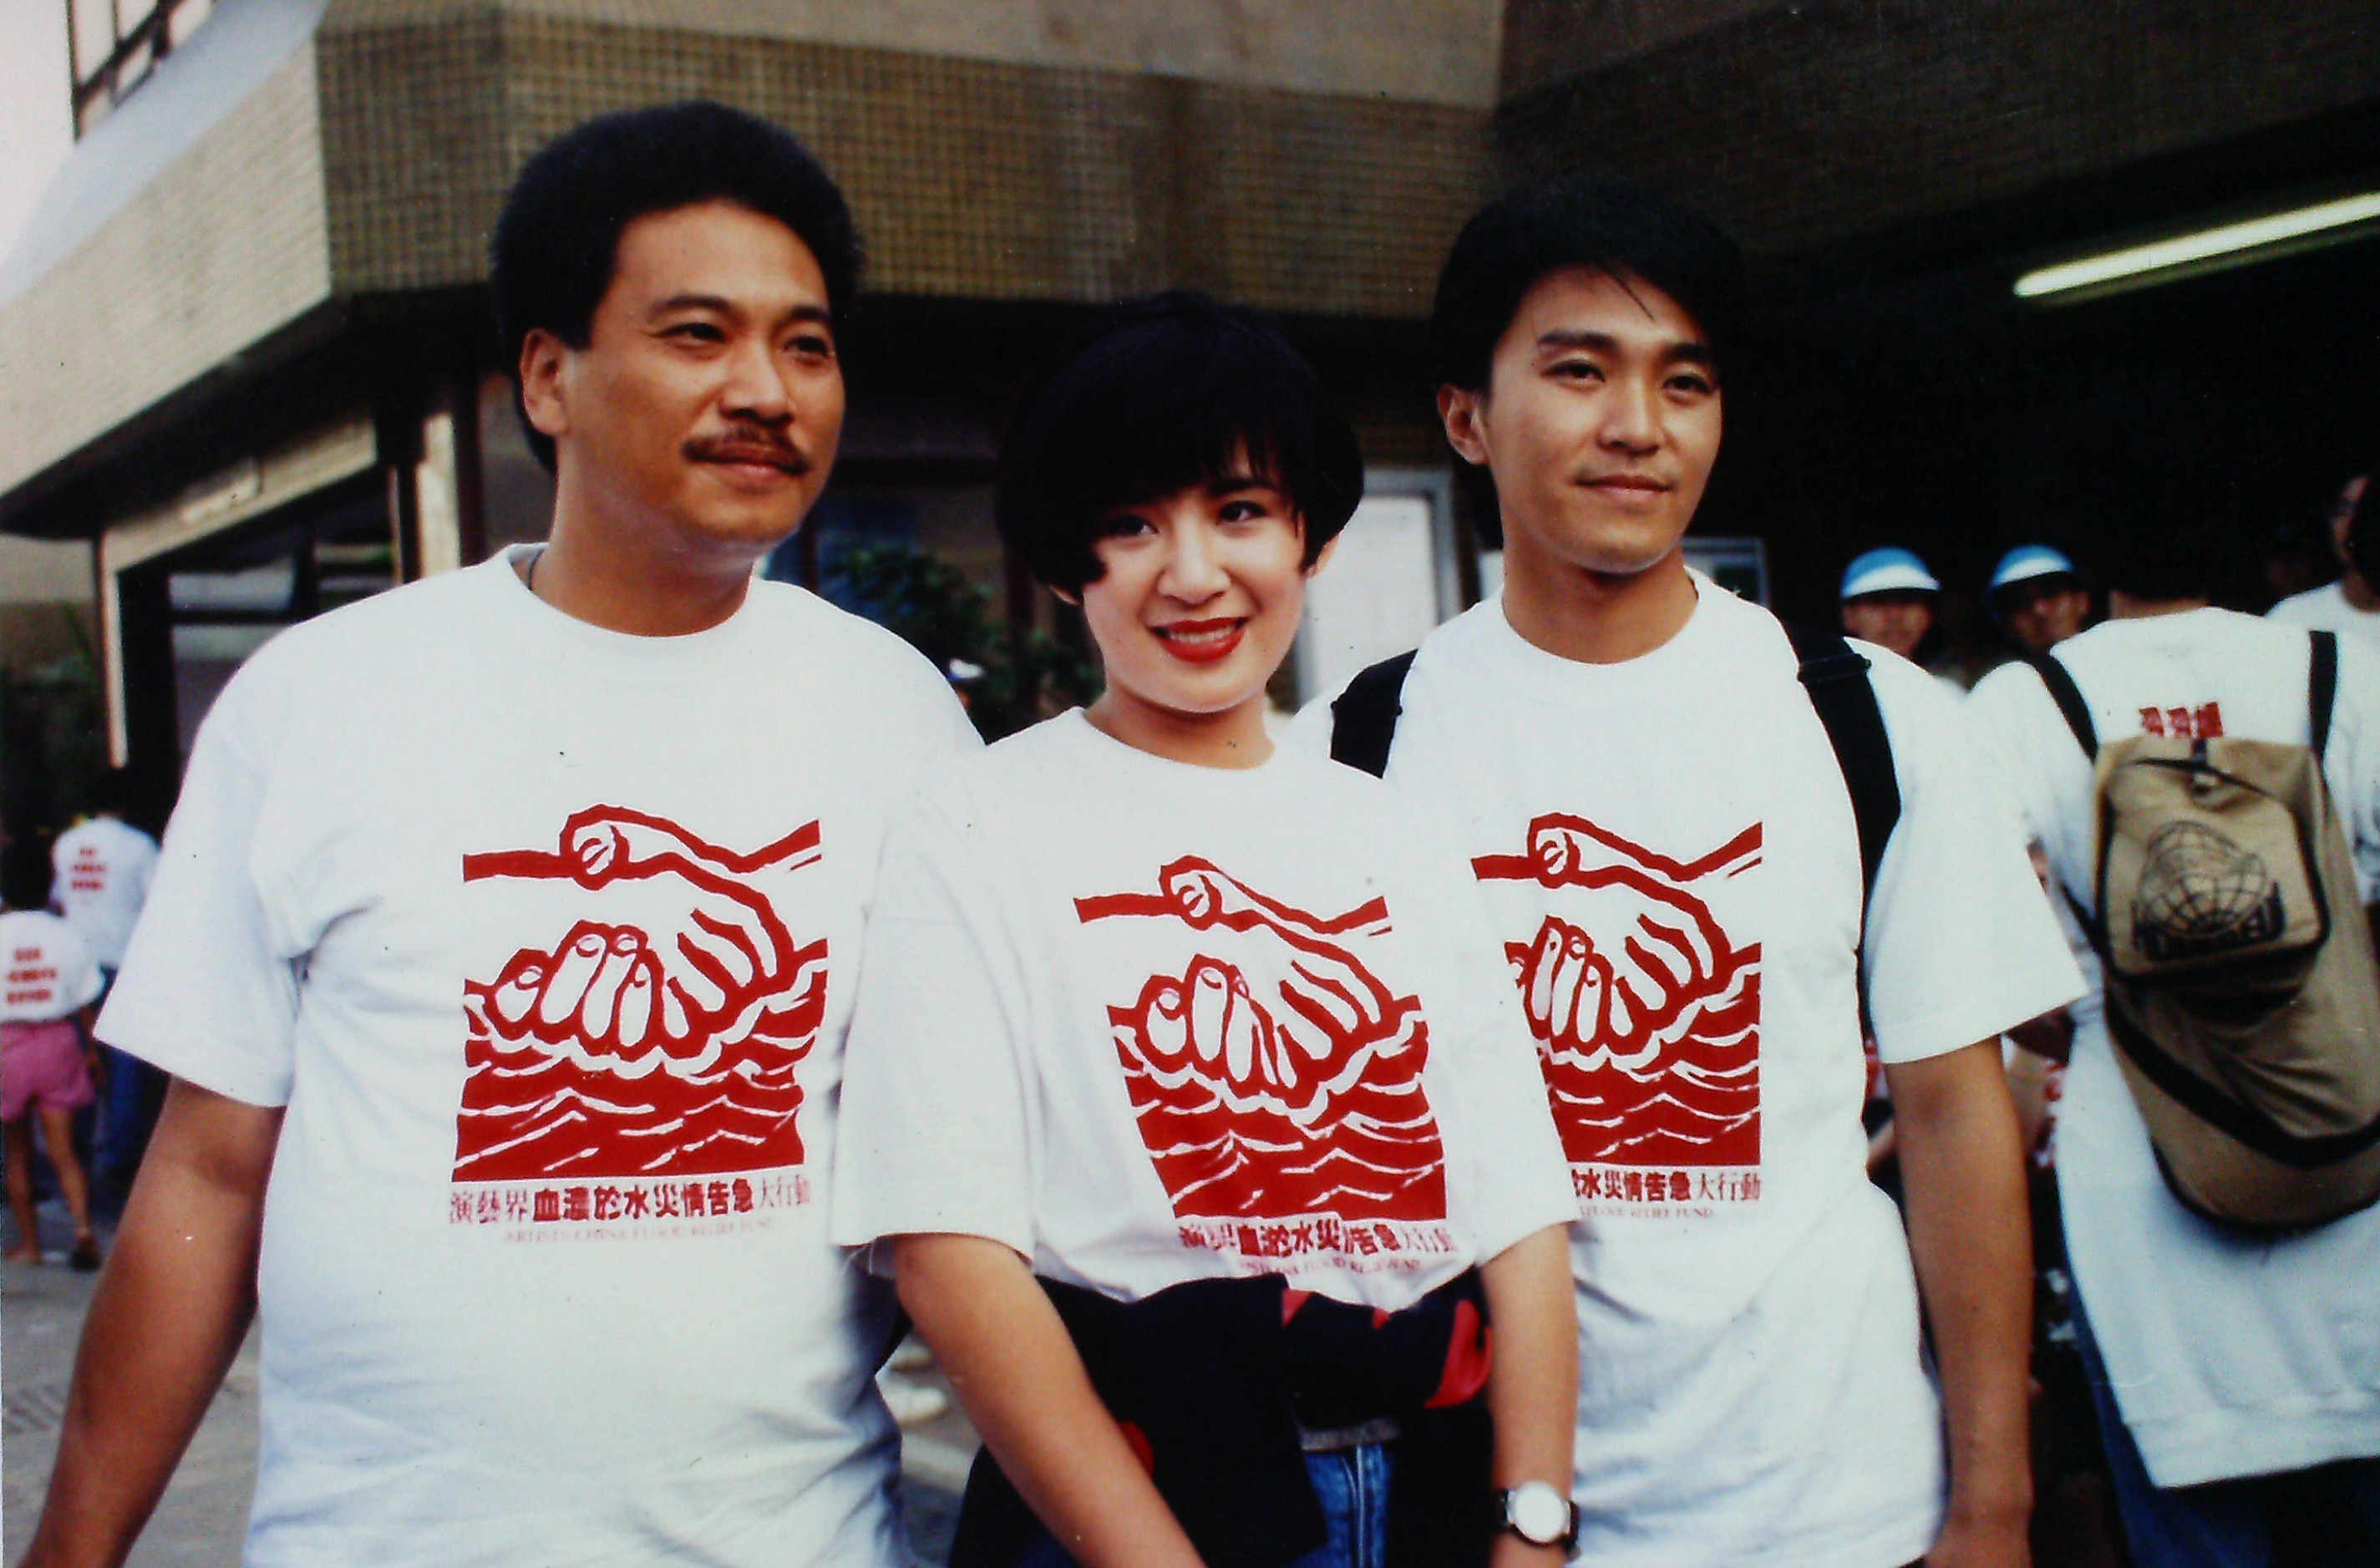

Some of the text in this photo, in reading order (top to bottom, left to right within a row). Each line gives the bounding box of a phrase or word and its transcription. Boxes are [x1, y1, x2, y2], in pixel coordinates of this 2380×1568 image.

[1571, 1168, 1761, 1203] 水災情告急大行動
